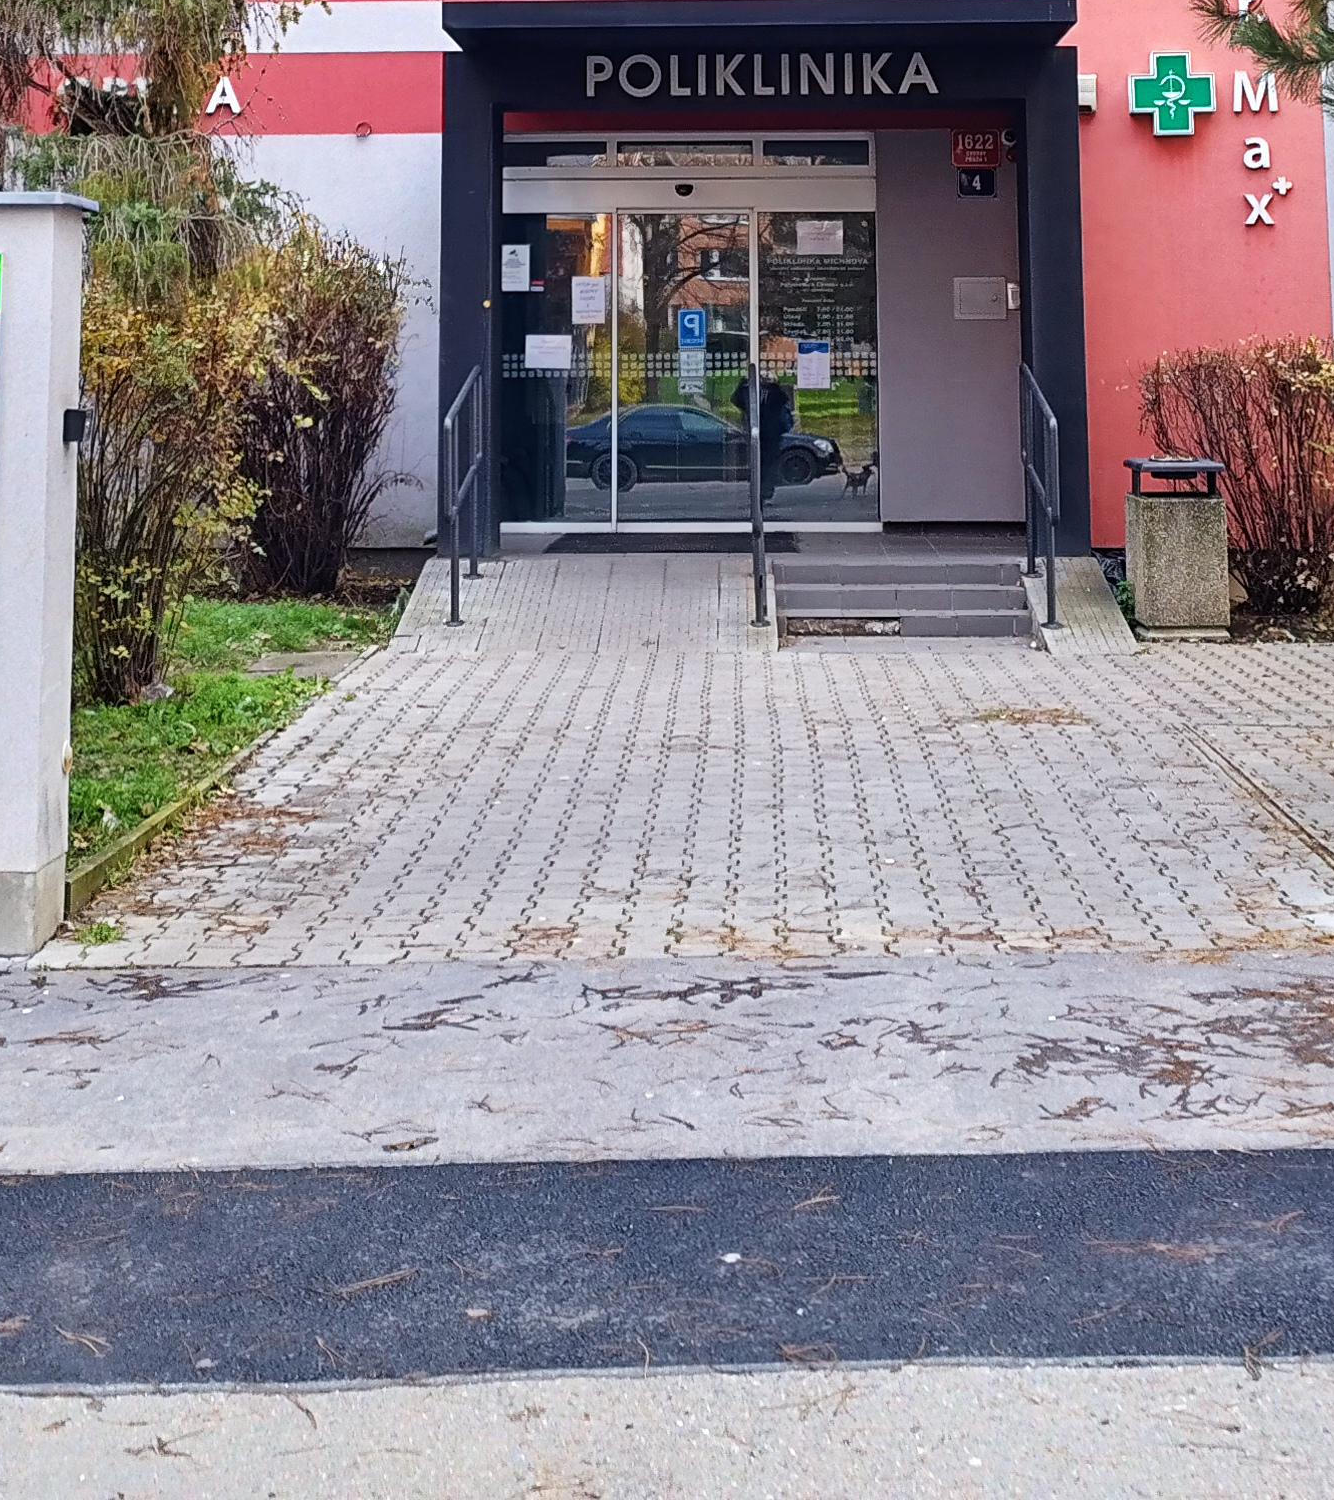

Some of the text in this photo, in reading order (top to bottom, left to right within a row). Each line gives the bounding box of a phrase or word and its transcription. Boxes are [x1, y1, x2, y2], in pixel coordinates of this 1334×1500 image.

[585, 51, 939, 98] POLIKLINIKA
[957, 133, 994, 150] 1622
[972, 174, 982, 191] 4
